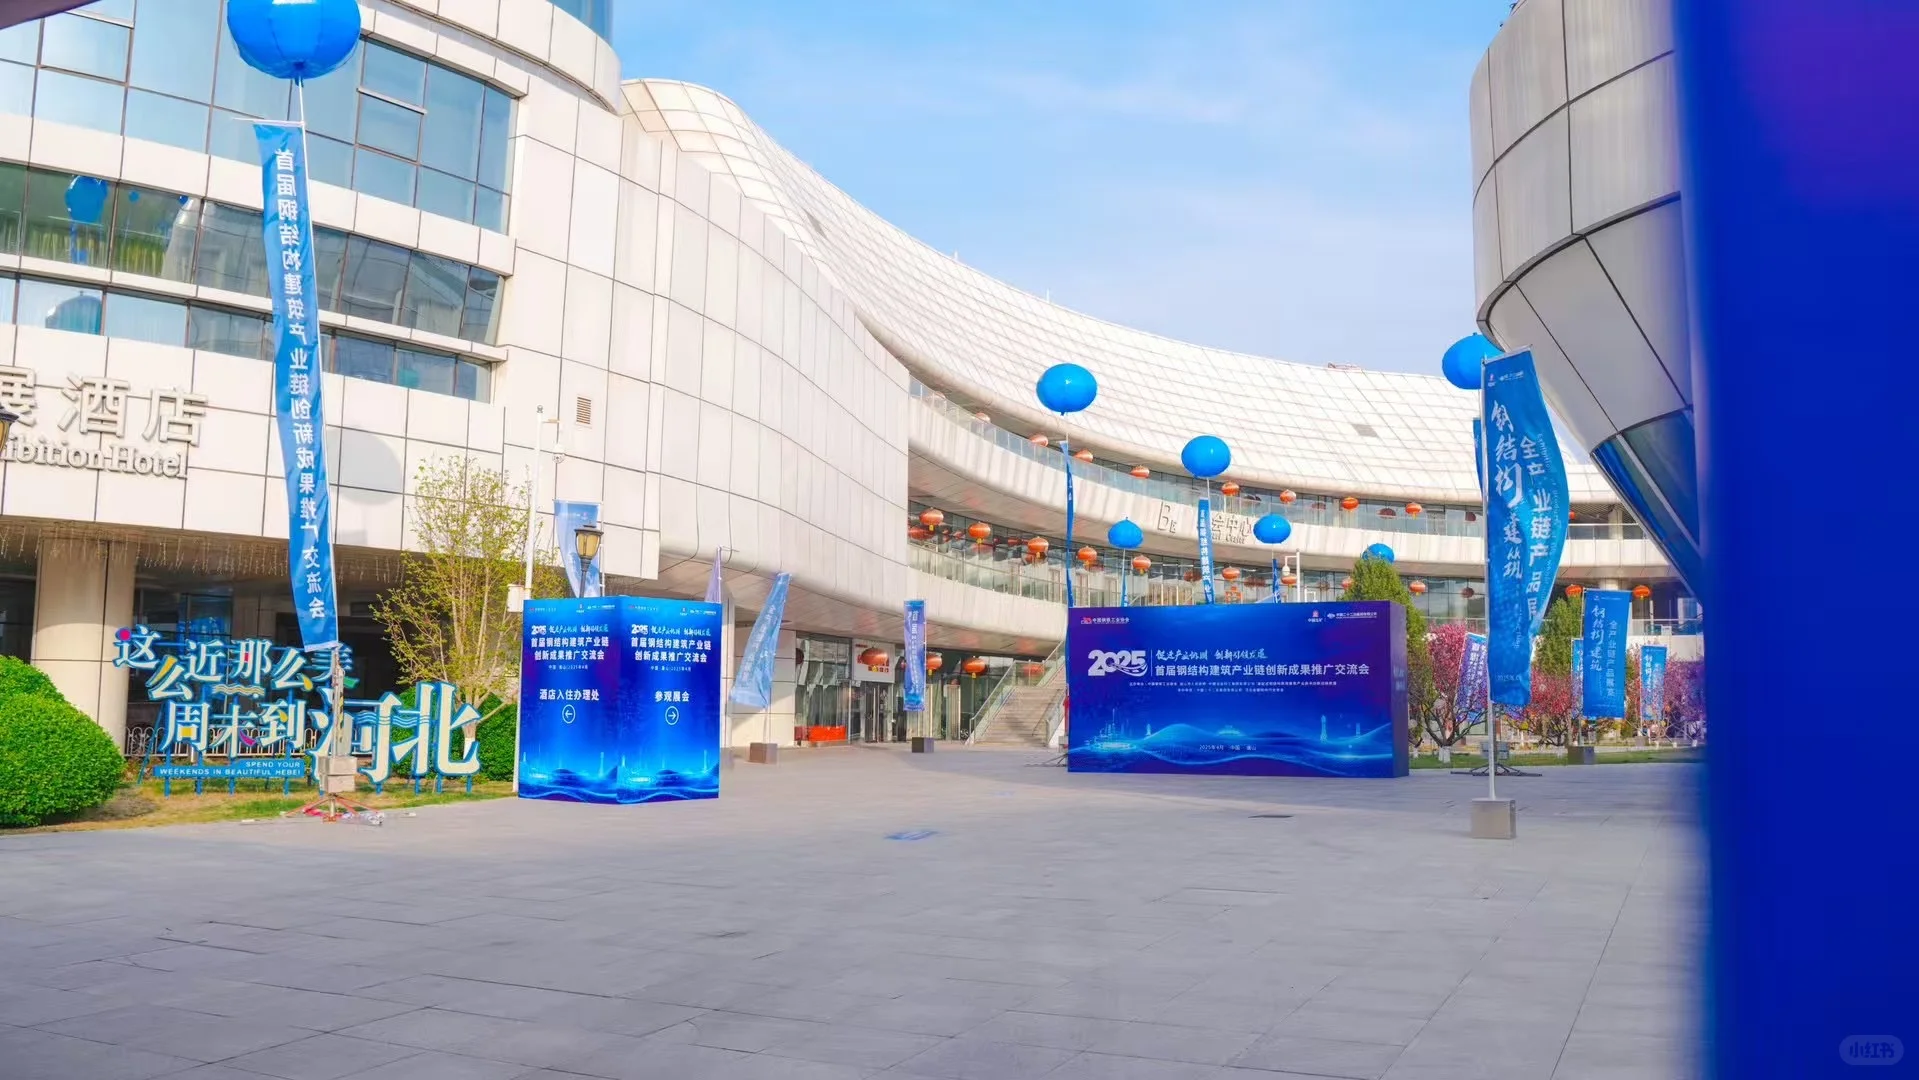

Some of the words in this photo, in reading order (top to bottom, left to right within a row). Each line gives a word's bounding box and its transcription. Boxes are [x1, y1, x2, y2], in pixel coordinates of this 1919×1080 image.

[3, 433, 104, 471] ibition
[105, 444, 188, 480] Hotel
[1491, 400, 1524, 579] 钢结构建筑
[531, 636, 609, 648] 首届钢结构建筑产业链
[631, 637, 712, 650] 首届钢结构建筑产业链
[534, 650, 605, 660] 创新成果推广交流会
[635, 650, 707, 663] 创新成果推广交流会
[113, 624, 360, 701] 这么近那么美
[1087, 649, 1149, 677] 2025
[1155, 663, 1370, 676] 首届钢结构建筑产业链创新成果推广交流会
[539, 688, 600, 701] 酒店入住办理处
[655, 691, 690, 703] 参观展会
